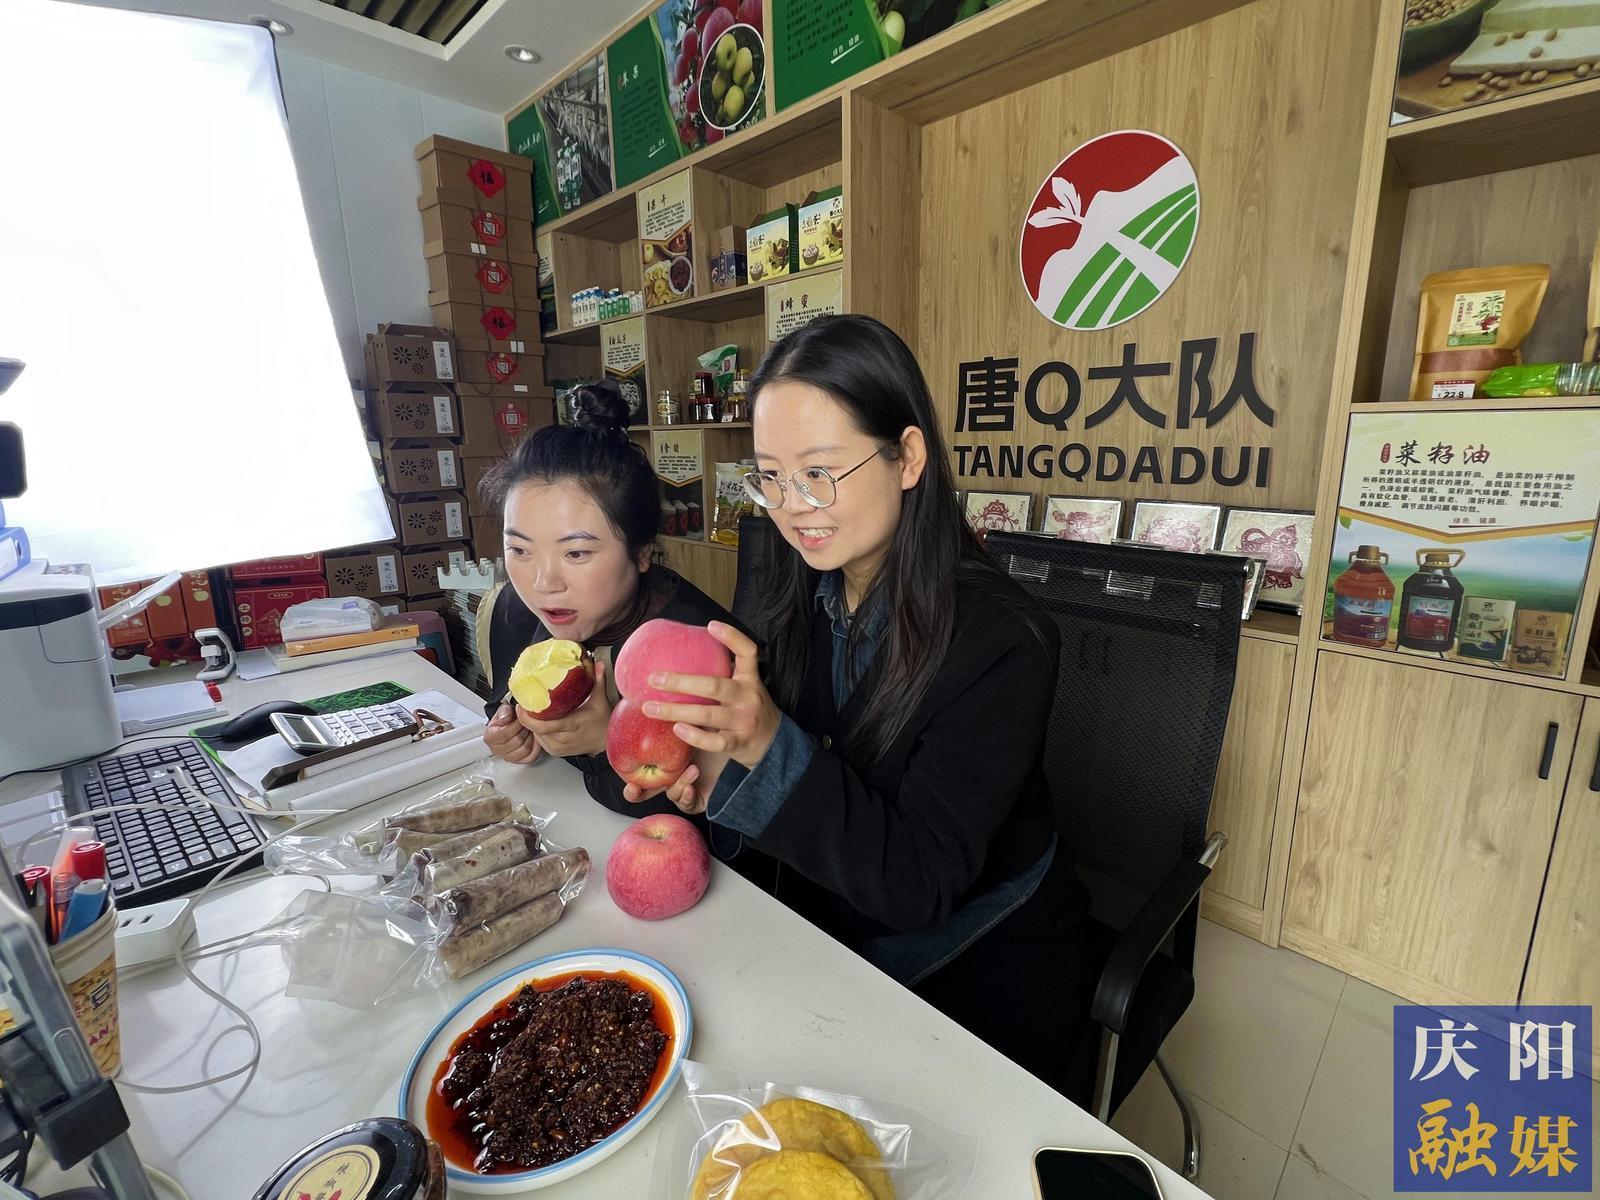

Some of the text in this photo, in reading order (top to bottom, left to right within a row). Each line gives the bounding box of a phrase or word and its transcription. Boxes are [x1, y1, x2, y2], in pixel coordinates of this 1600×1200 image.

[785, 294, 809, 311] 蜂蜜
[954, 332, 1275, 433] 唐Q大队
[953, 443, 1271, 488] TANGQDADUI
[1395, 440, 1491, 467] 菜籽油
